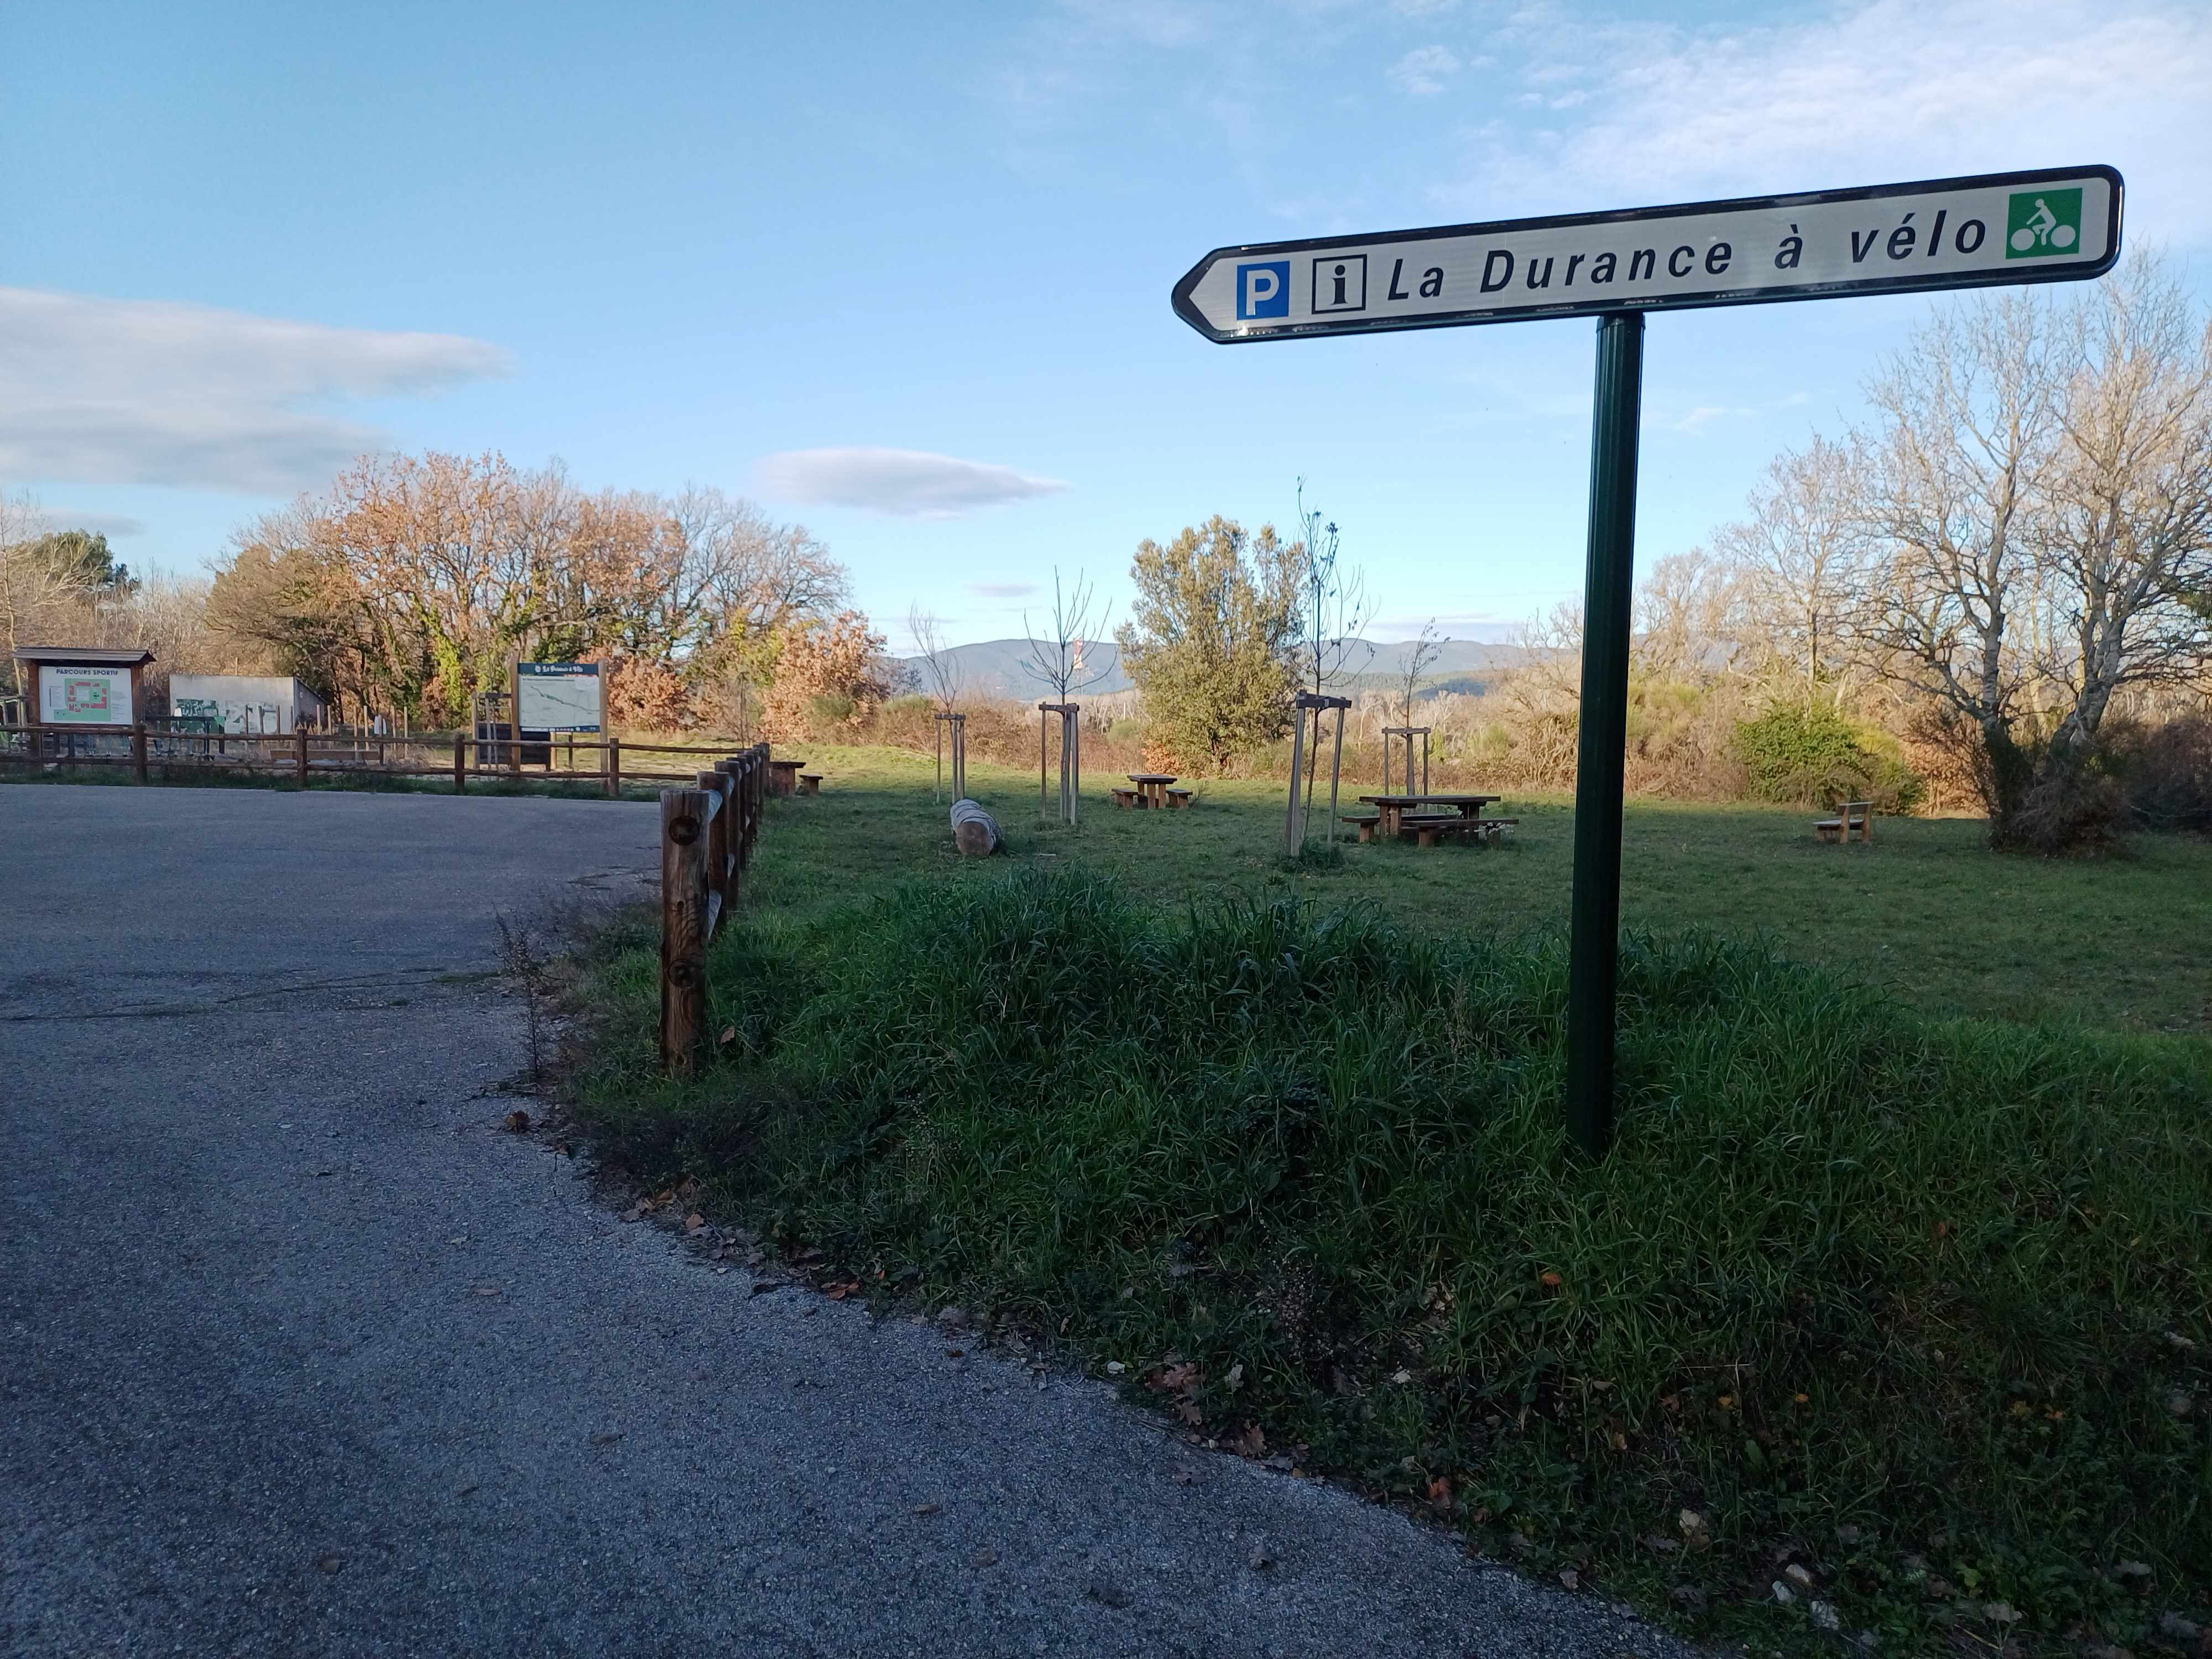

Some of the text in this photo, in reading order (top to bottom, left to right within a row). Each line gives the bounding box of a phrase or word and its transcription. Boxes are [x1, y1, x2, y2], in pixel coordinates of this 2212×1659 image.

[1246, 270, 1280, 316] P
[1388, 258, 1443, 301] La
[1480, 242, 1732, 293] Durance
[1775, 225, 1803, 269] à
[1851, 210, 1986, 263] vélo
